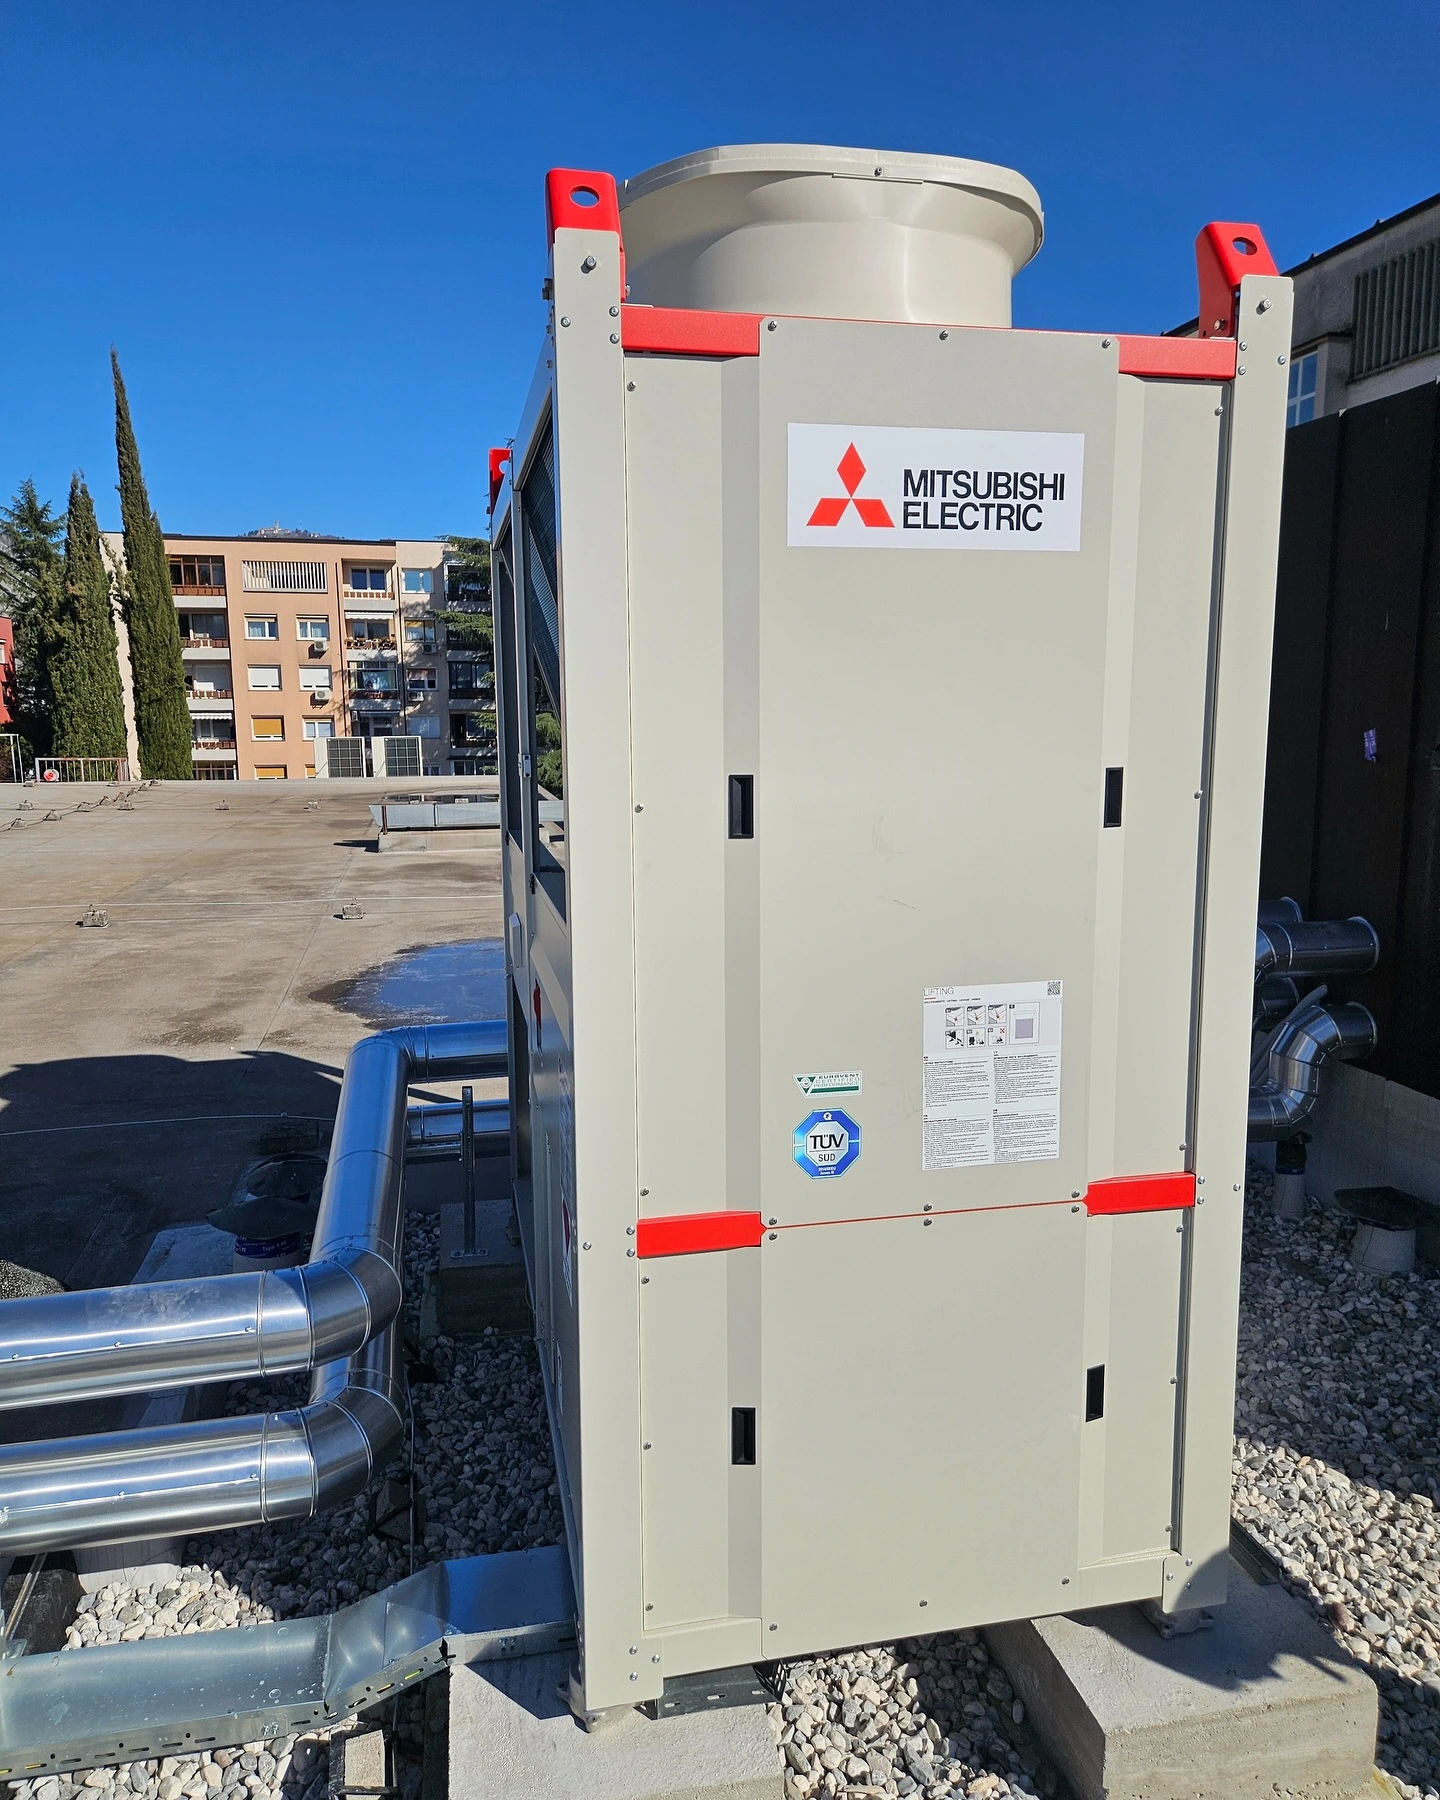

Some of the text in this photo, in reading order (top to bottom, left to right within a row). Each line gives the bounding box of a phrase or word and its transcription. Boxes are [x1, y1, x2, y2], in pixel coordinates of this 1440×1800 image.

[903, 469, 1065, 501] MITSUBISHI
[902, 501, 1043, 532] ELECTRIC
[923, 987, 954, 996] LIFTING
[809, 1133, 845, 1150] TÜV
